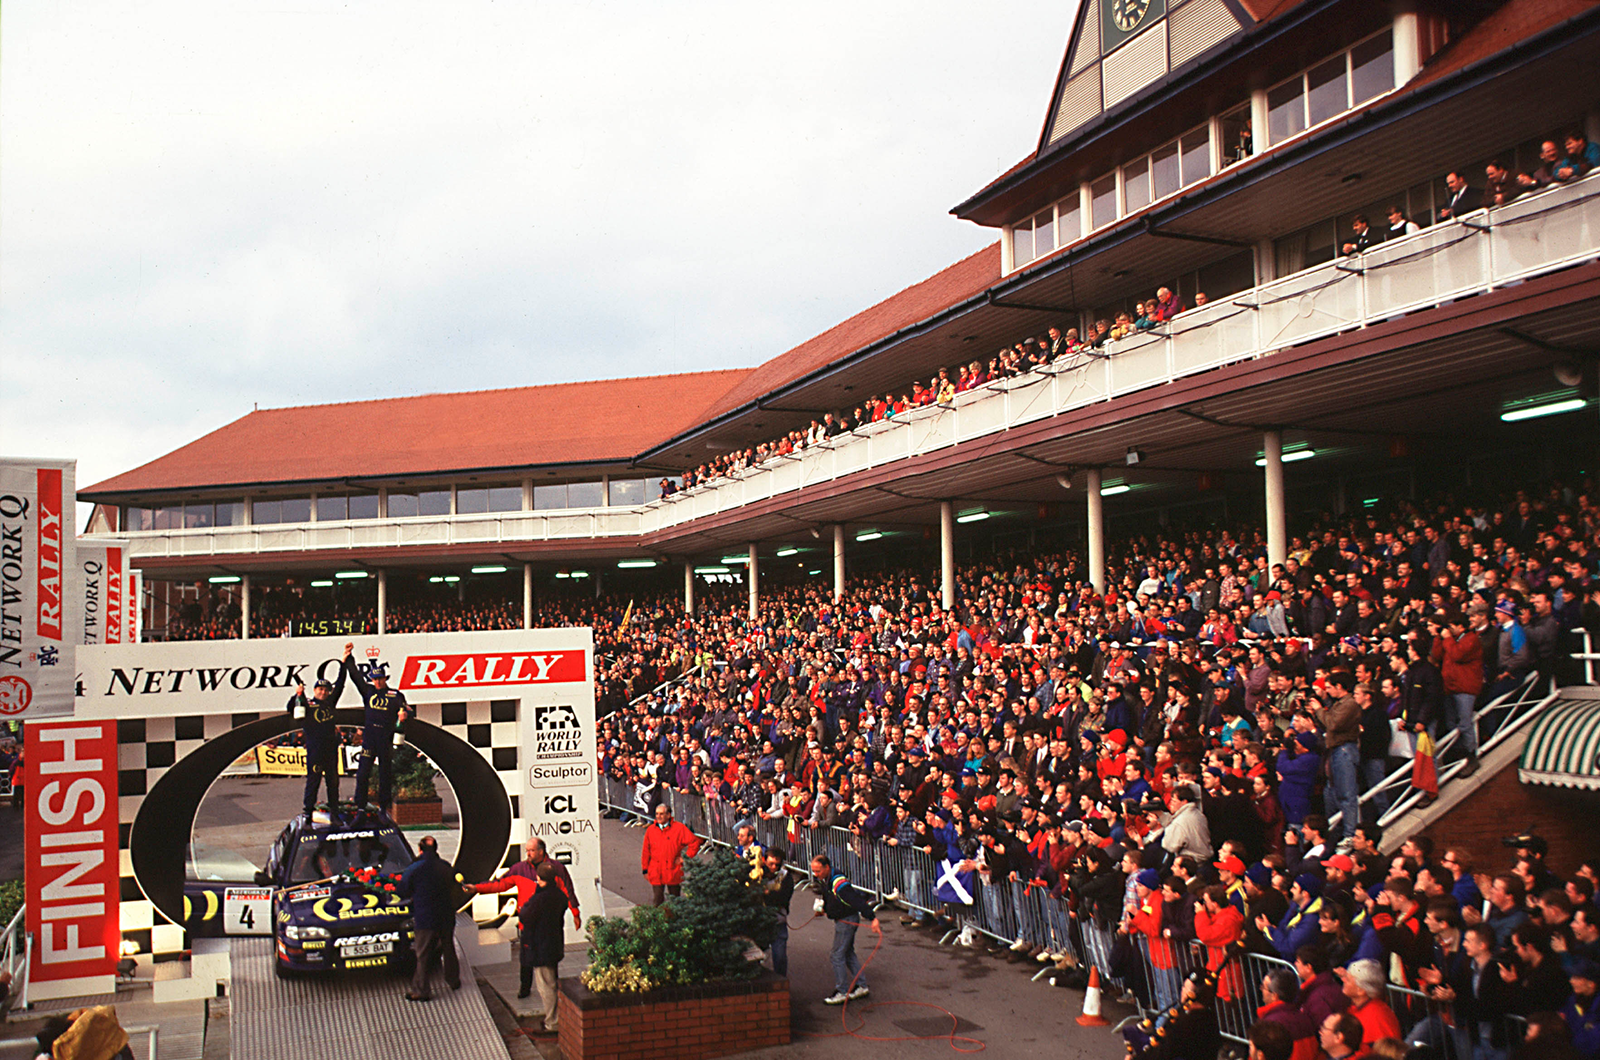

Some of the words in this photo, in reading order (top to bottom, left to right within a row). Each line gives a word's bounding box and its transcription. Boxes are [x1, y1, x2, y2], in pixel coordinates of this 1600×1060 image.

[0, 494, 29, 520] Q
[40, 502, 60, 631] RALLY
[84, 560, 103, 576] Q
[0, 522, 22, 668] NETWORK
[107, 565, 120, 643] RALLY
[104, 664, 307, 696] NETWORK
[410, 654, 564, 686] RALLY
[536, 730, 582, 742] WORLD
[536, 740, 582, 753] RALLY
[533, 766, 588, 779] Sculptor
[530, 819, 595, 837] MINOLTA
[38, 726, 105, 965] FINISH
[239, 904, 255, 929] 4
[338, 906, 409, 919] SUBARU
[333, 931, 400, 948] REPSOL
[353, 945, 370, 955] 555
[372, 943, 389, 953] BAT
